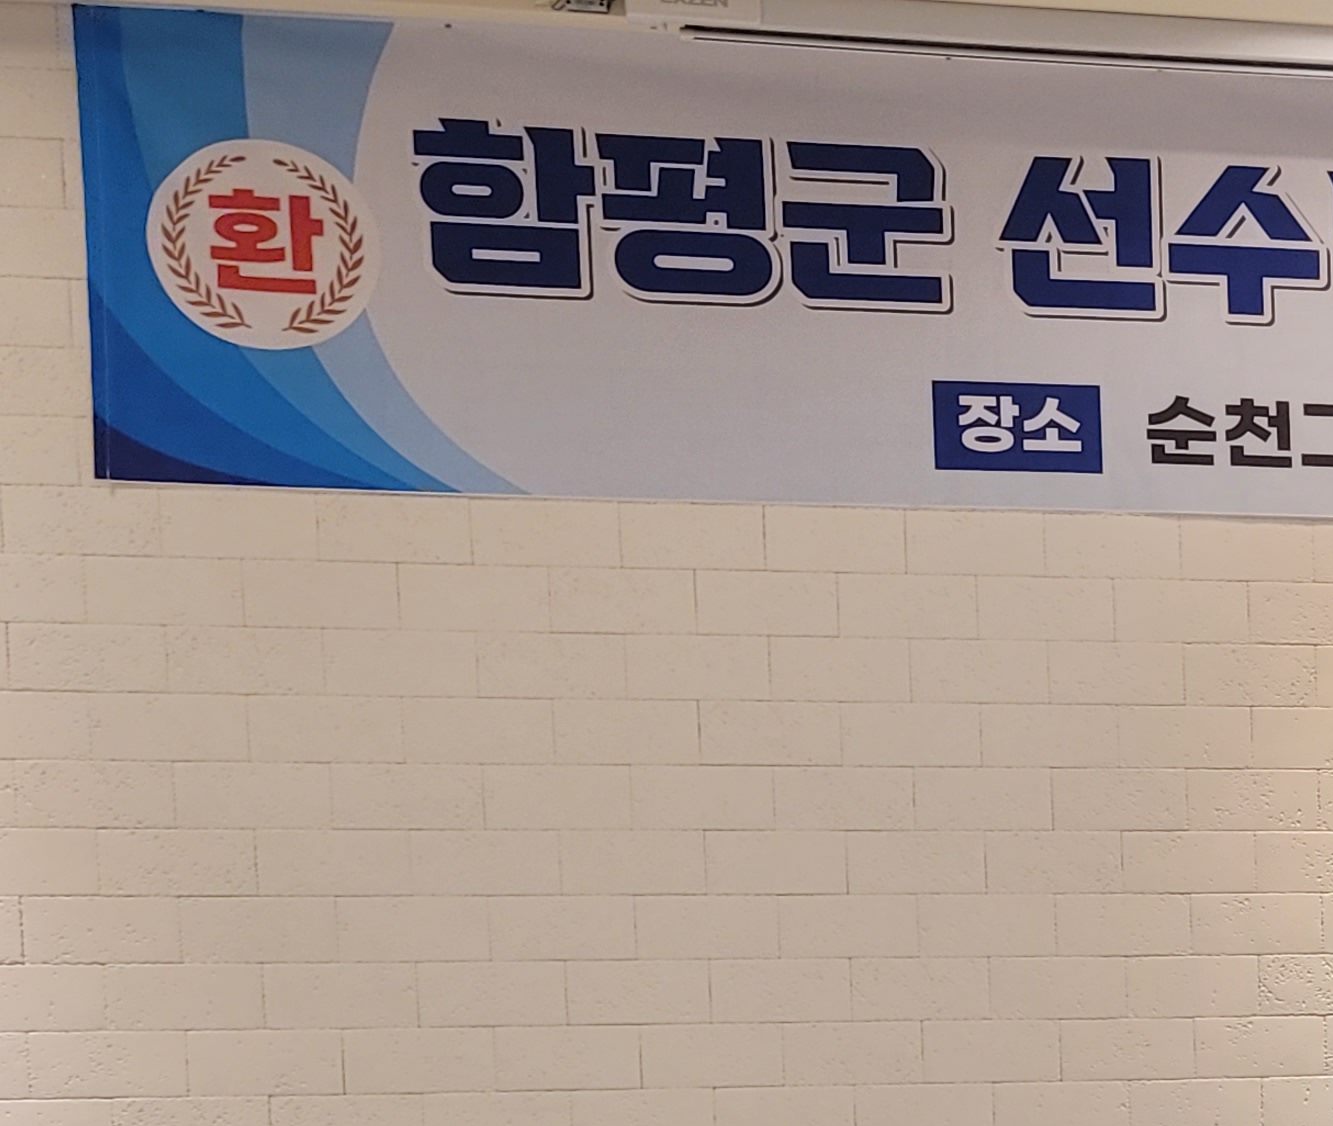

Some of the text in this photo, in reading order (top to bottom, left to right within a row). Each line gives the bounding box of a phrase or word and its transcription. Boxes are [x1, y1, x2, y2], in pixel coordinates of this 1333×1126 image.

[209, 190, 324, 297] 환
[412, 116, 956, 316] 함평군
[958, 394, 1083, 453] 장소
